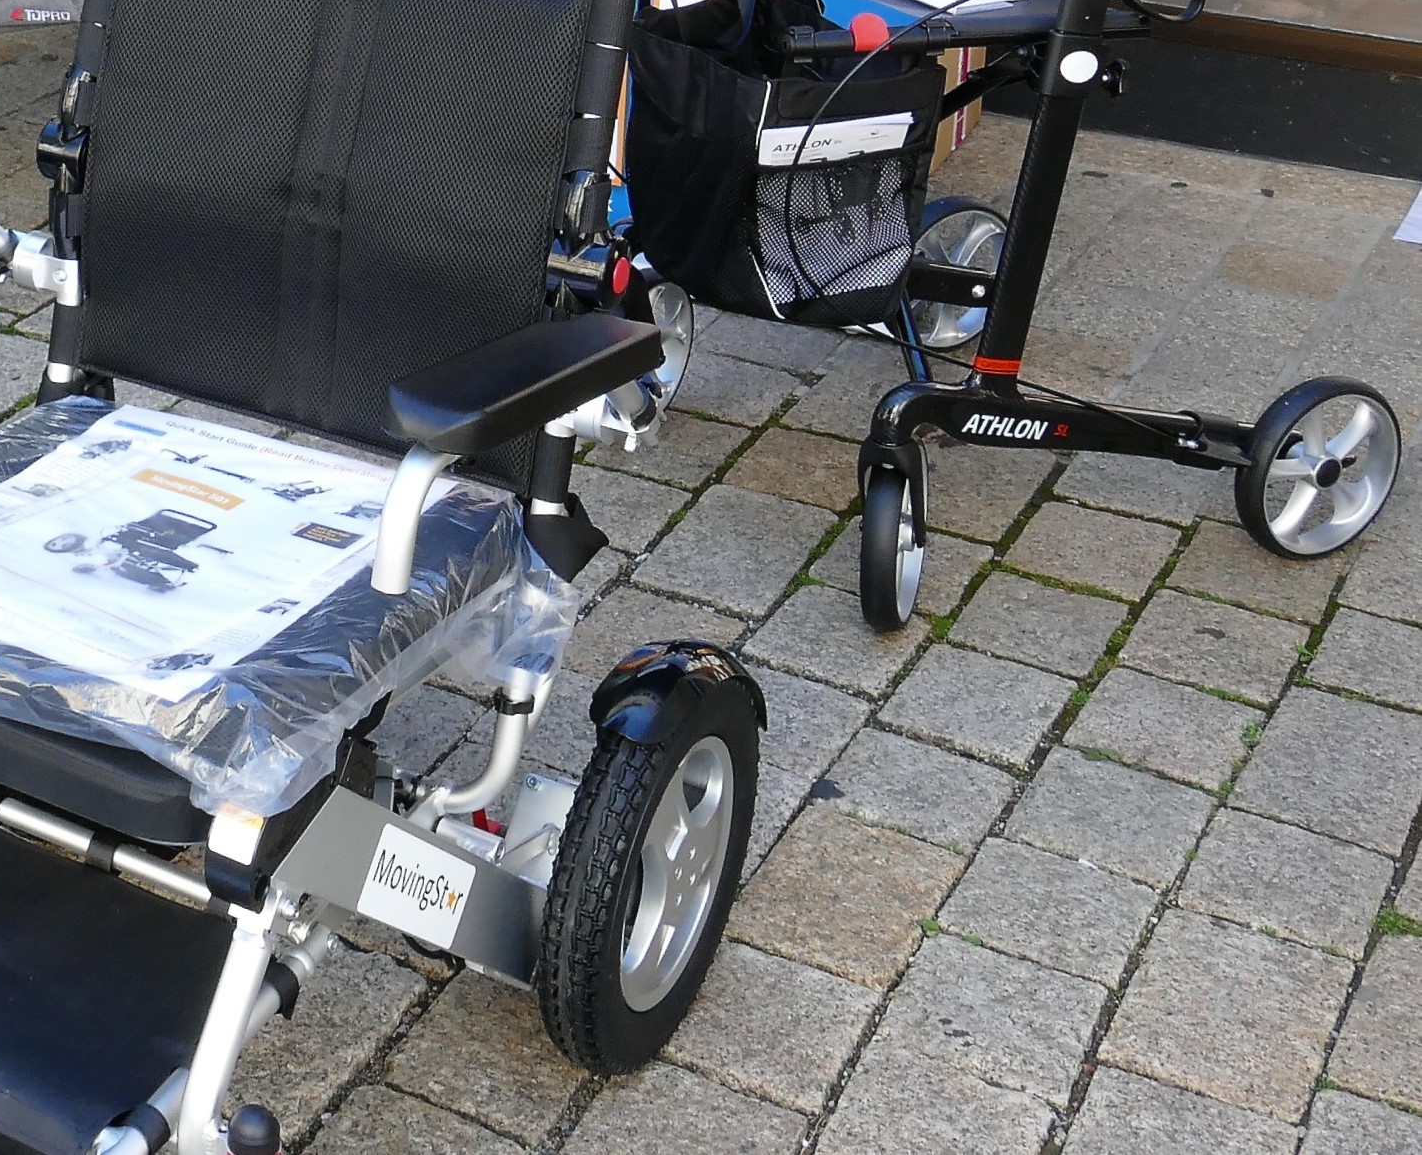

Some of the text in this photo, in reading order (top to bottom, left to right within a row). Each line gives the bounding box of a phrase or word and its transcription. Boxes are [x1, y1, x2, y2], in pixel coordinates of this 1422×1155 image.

[23, 8, 71, 22] TOPRO
[166, 420, 196, 434] Quick
[198, 430, 224, 442] Start
[226, 438, 258, 451] Guide
[961, 413, 1049, 440] ATHLON
[373, 849, 463, 915] MovingStr
